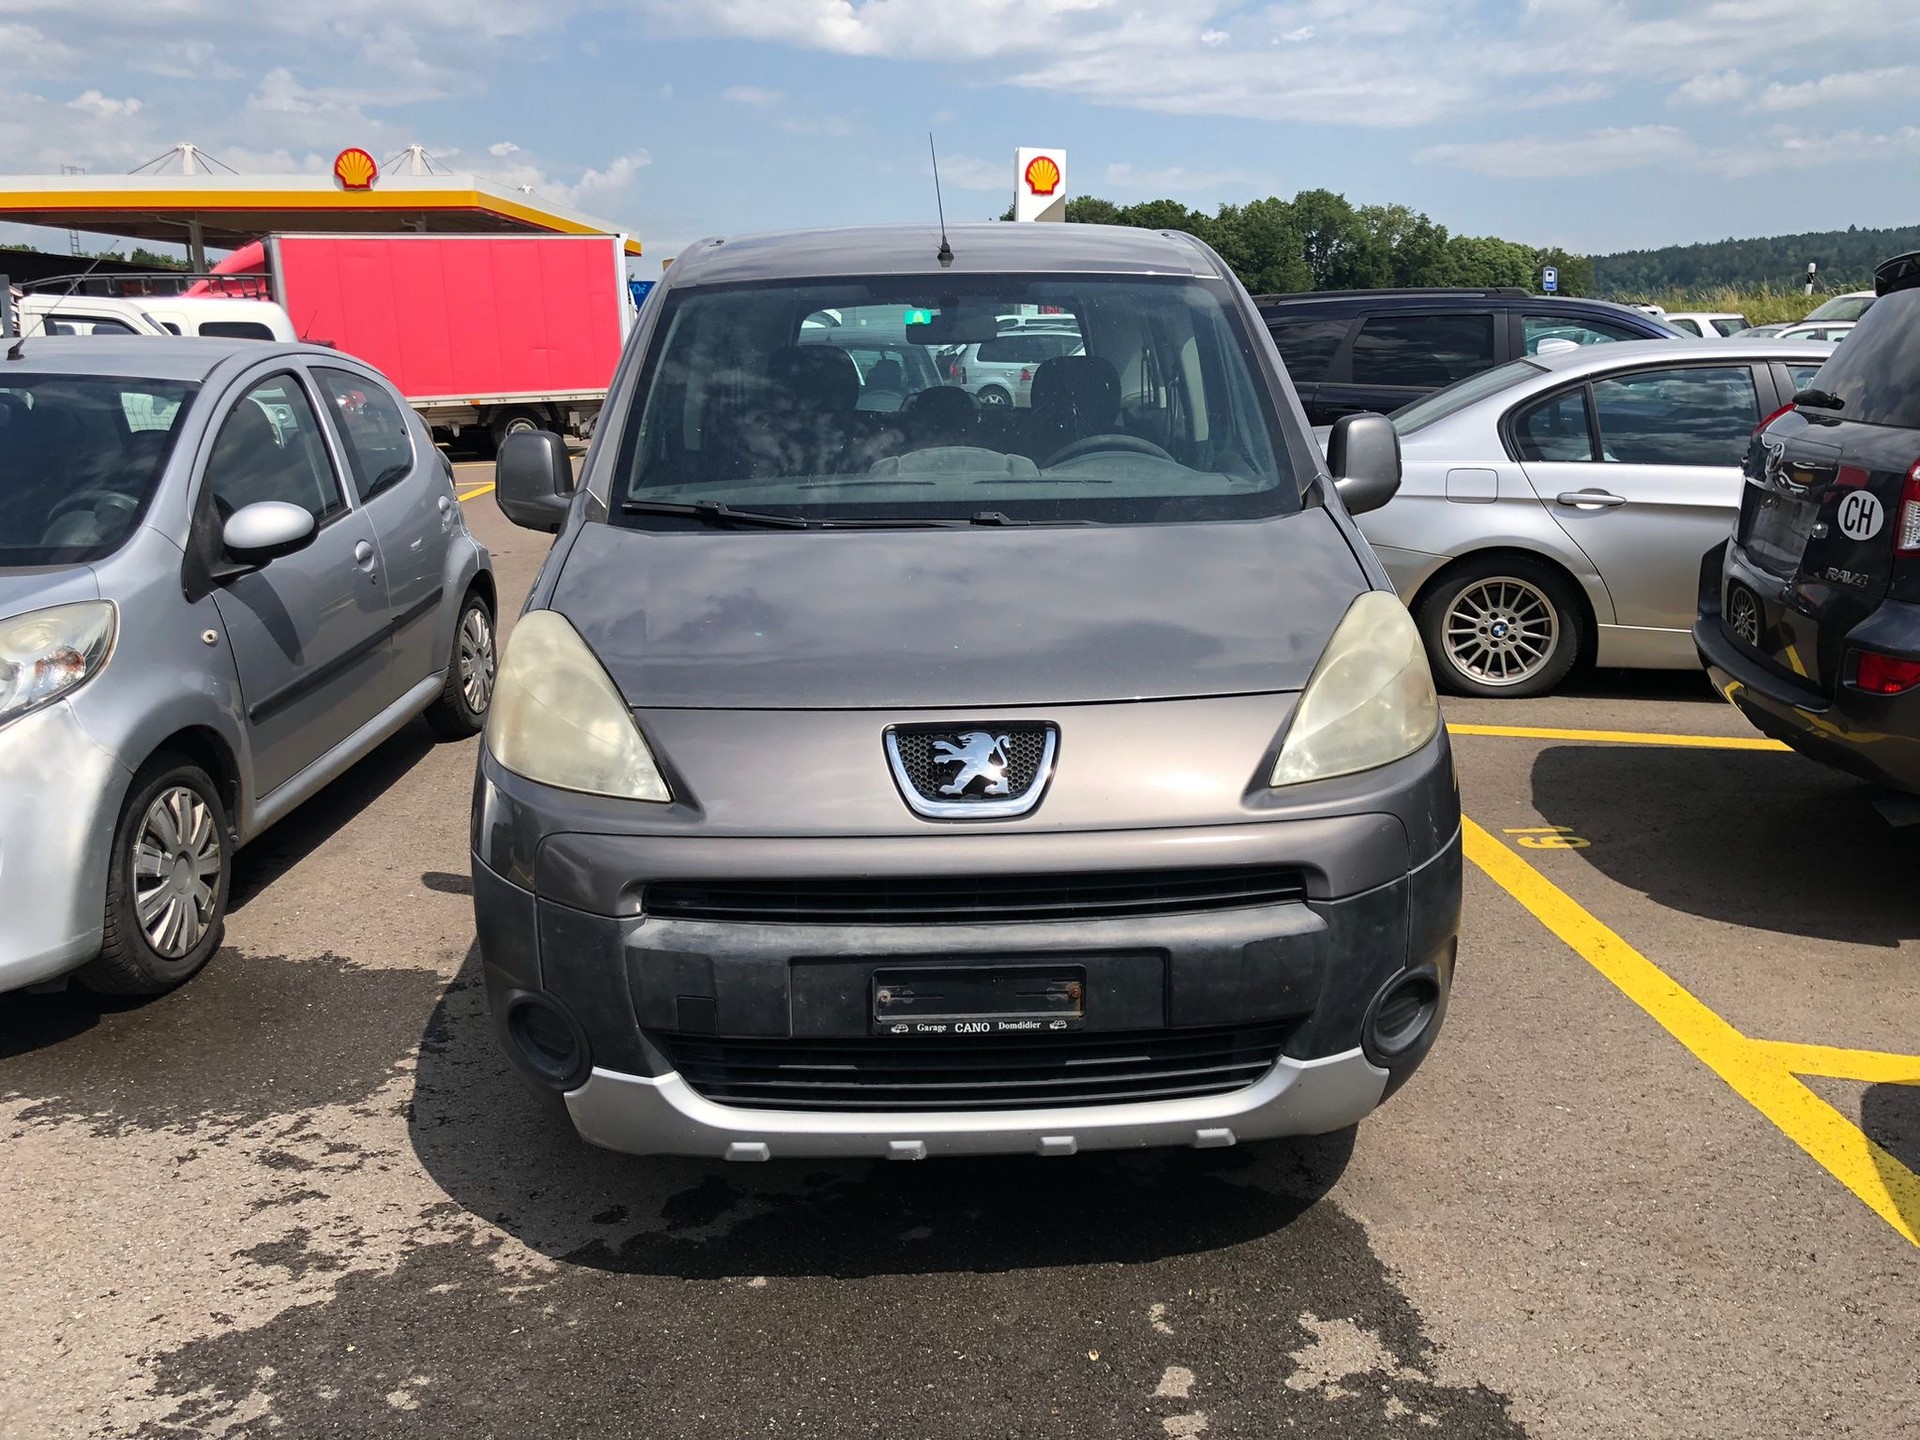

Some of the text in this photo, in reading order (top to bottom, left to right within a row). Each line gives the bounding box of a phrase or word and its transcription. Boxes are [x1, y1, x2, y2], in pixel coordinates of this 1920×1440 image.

[1844, 496, 1874, 535] CH
[1825, 566, 1869, 588] RAV4
[917, 1021, 1041, 1033] Garage CANO Domdidier
